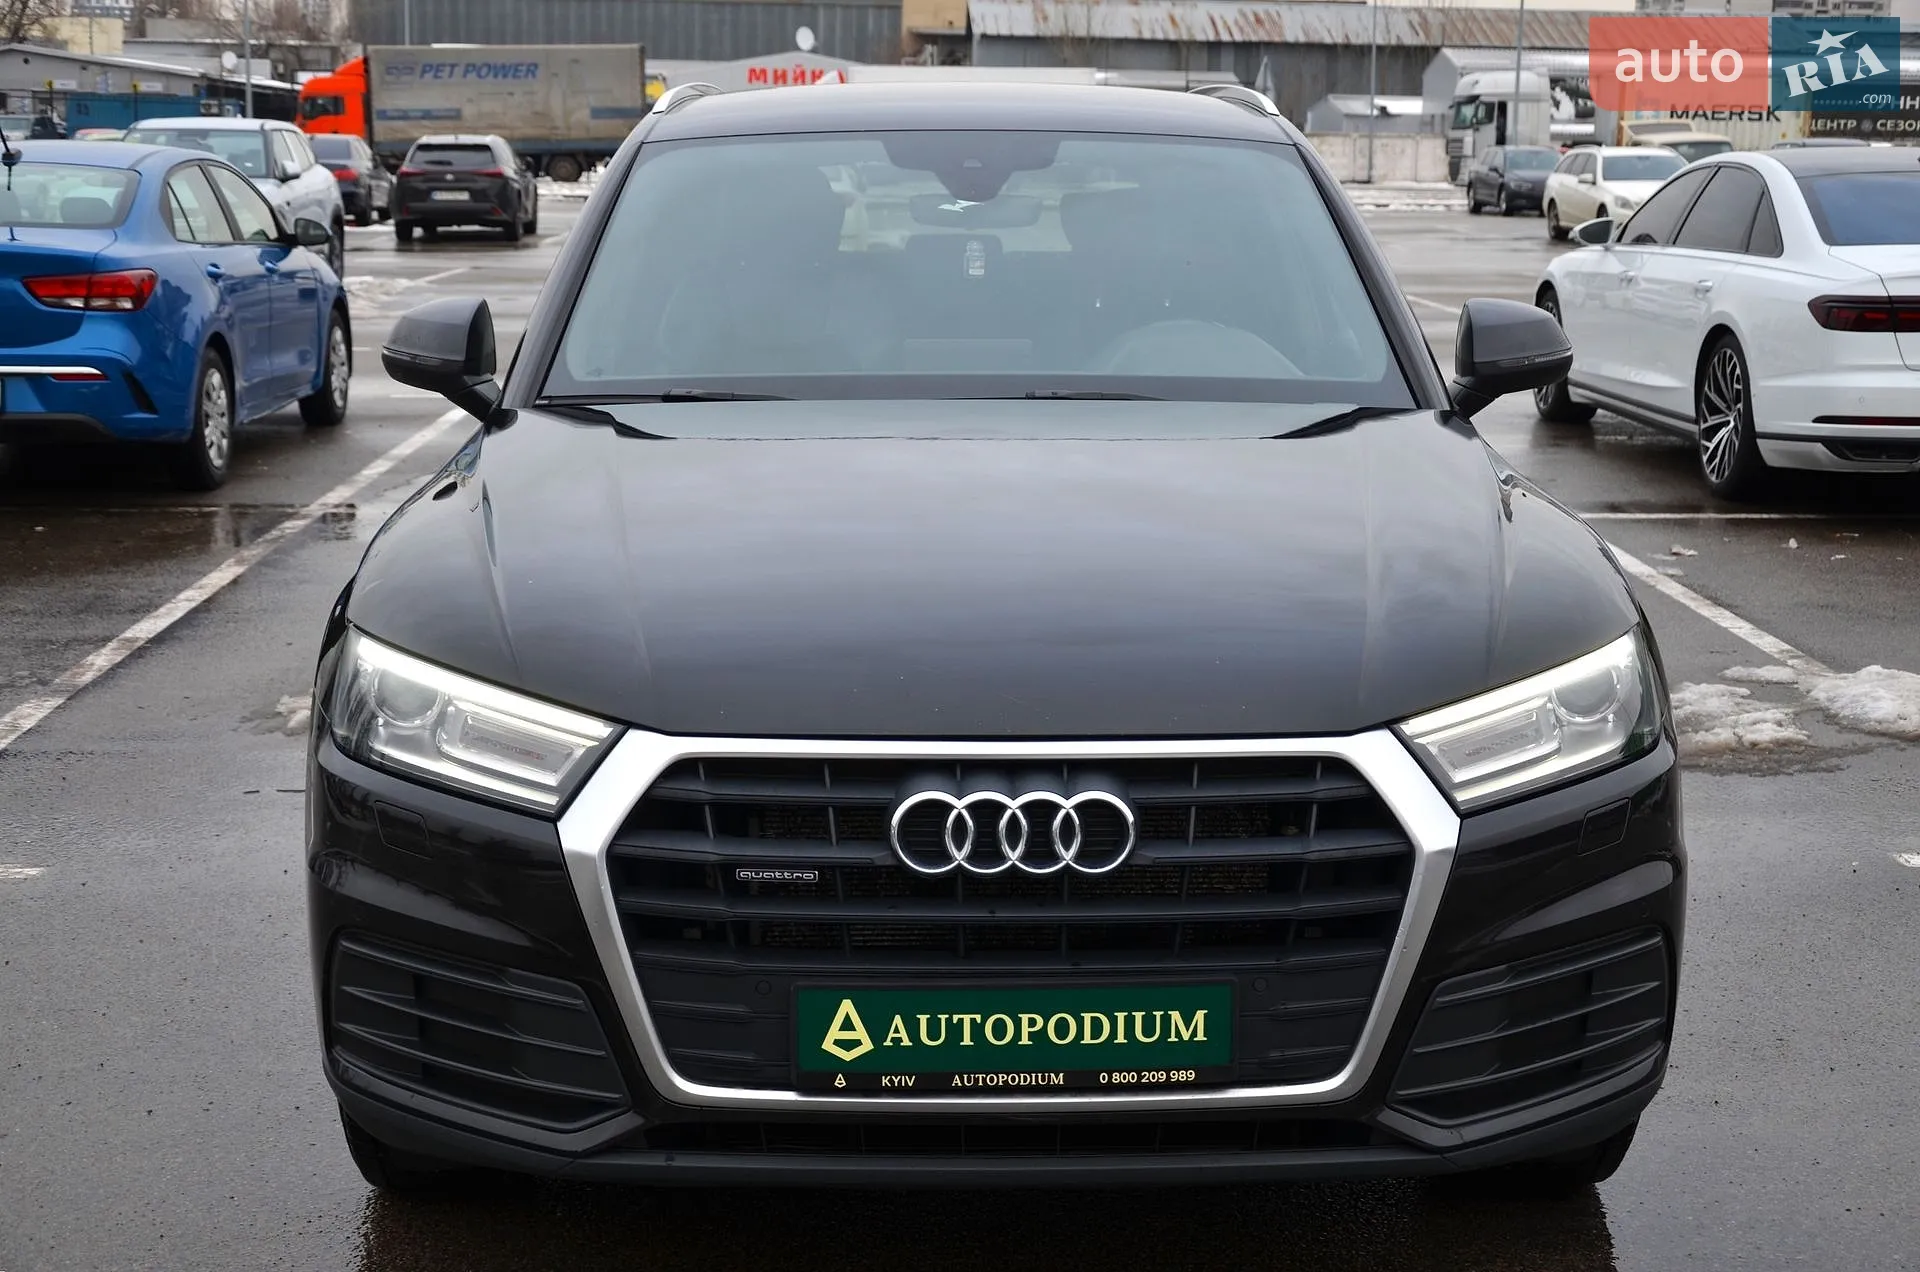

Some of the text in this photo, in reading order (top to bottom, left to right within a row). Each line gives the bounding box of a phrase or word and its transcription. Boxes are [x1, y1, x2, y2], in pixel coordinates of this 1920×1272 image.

[419, 63, 460, 79] PET
[463, 63, 539, 79] POWER
[1670, 104, 1781, 121] MAERSK
[740, 871, 814, 880] quattro
[883, 1010, 1208, 1046] AUTOPODIUM
[881, 1069, 1196, 1087] KYIV AUTOPODIUM 0 800 209 989
